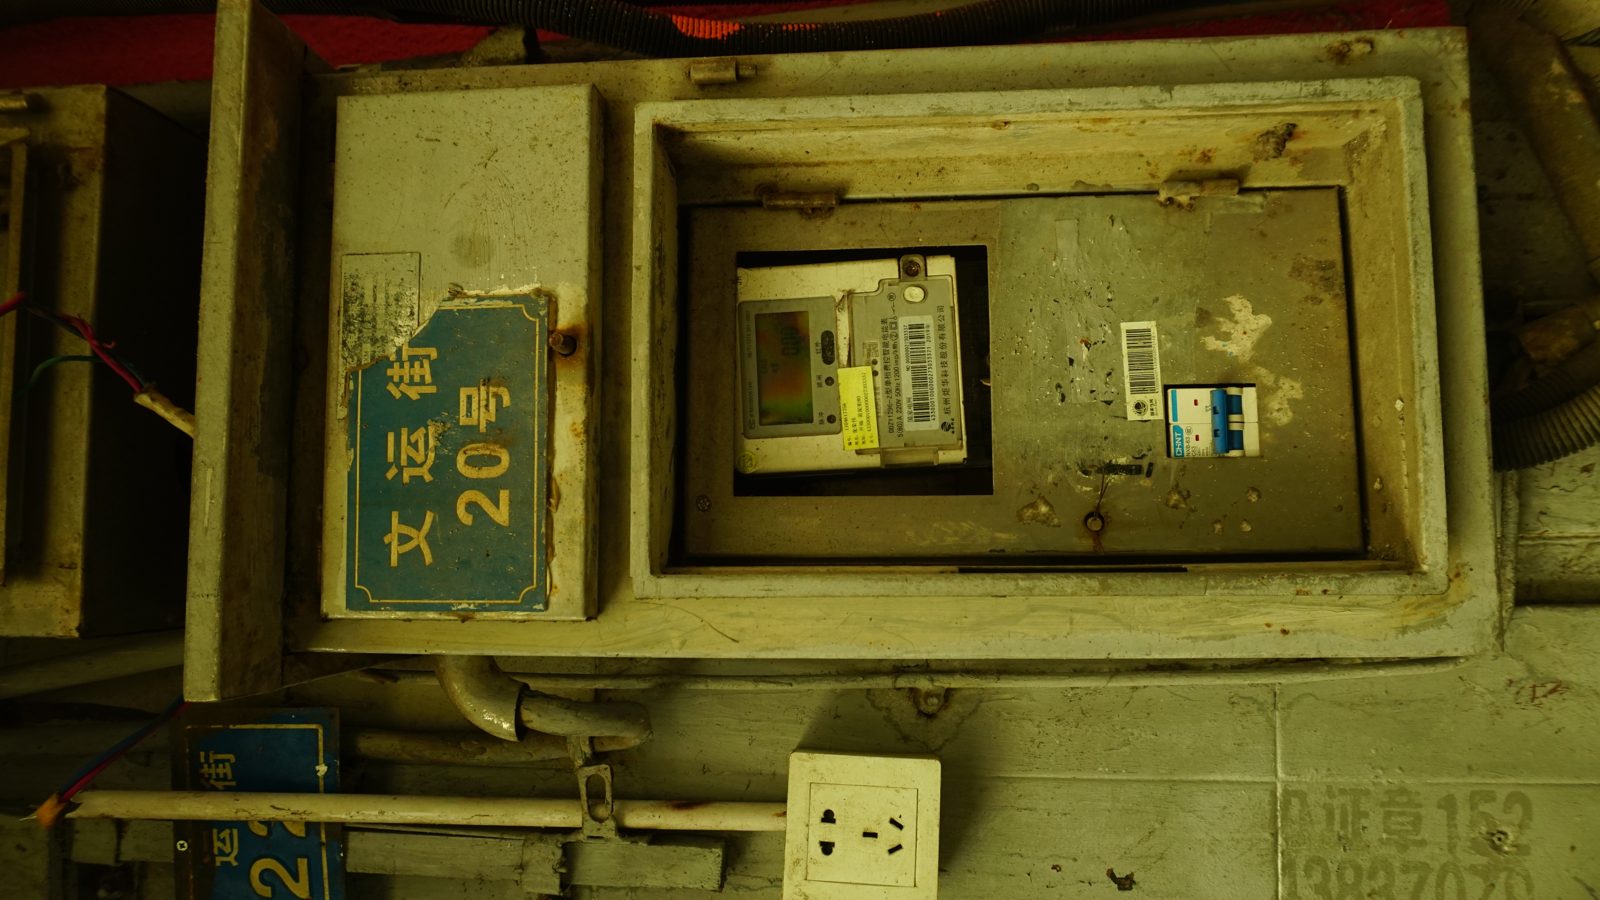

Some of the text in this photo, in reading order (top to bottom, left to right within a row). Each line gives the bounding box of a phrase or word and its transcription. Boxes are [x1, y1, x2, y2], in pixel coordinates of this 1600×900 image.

[384, 345, 438, 567] 文运街
[456, 379, 511, 528] 20号
